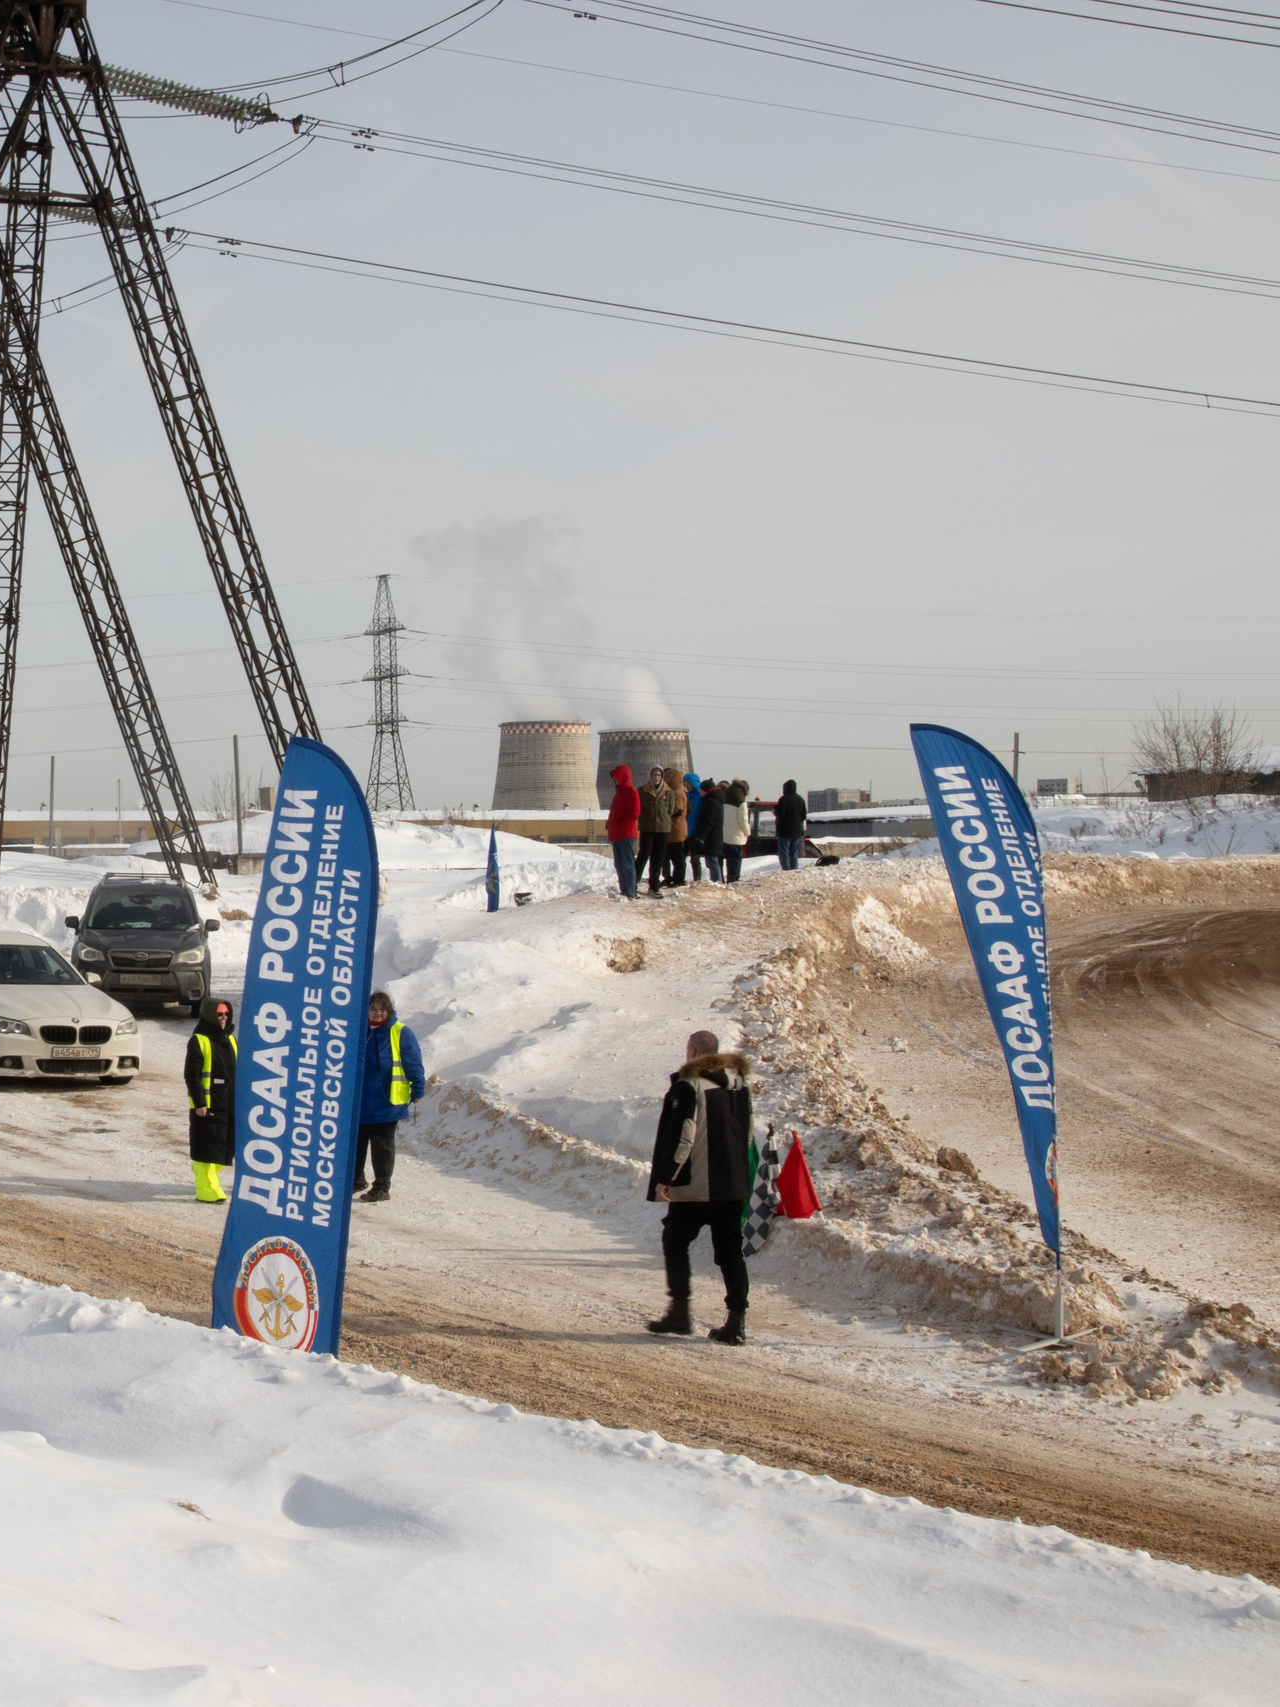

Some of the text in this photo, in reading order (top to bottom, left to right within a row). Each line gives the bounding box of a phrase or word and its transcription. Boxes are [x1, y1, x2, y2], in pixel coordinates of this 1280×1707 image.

[933, 765, 1014, 924] РОССИИ
[981, 777, 1041, 917] ОТДЕЛЕНИЕ
[238, 789, 318, 1217] ДОСААФ РОССИИ
[285, 804, 345, 1222] РЕГИОНАЛЬНОЕ ОТДЕЛЕНИЕ
[311, 868, 362, 1227] МОСКОВСКОЙ ОБЛАСТИ
[286, 1240, 318, 1305] РОССИИ
